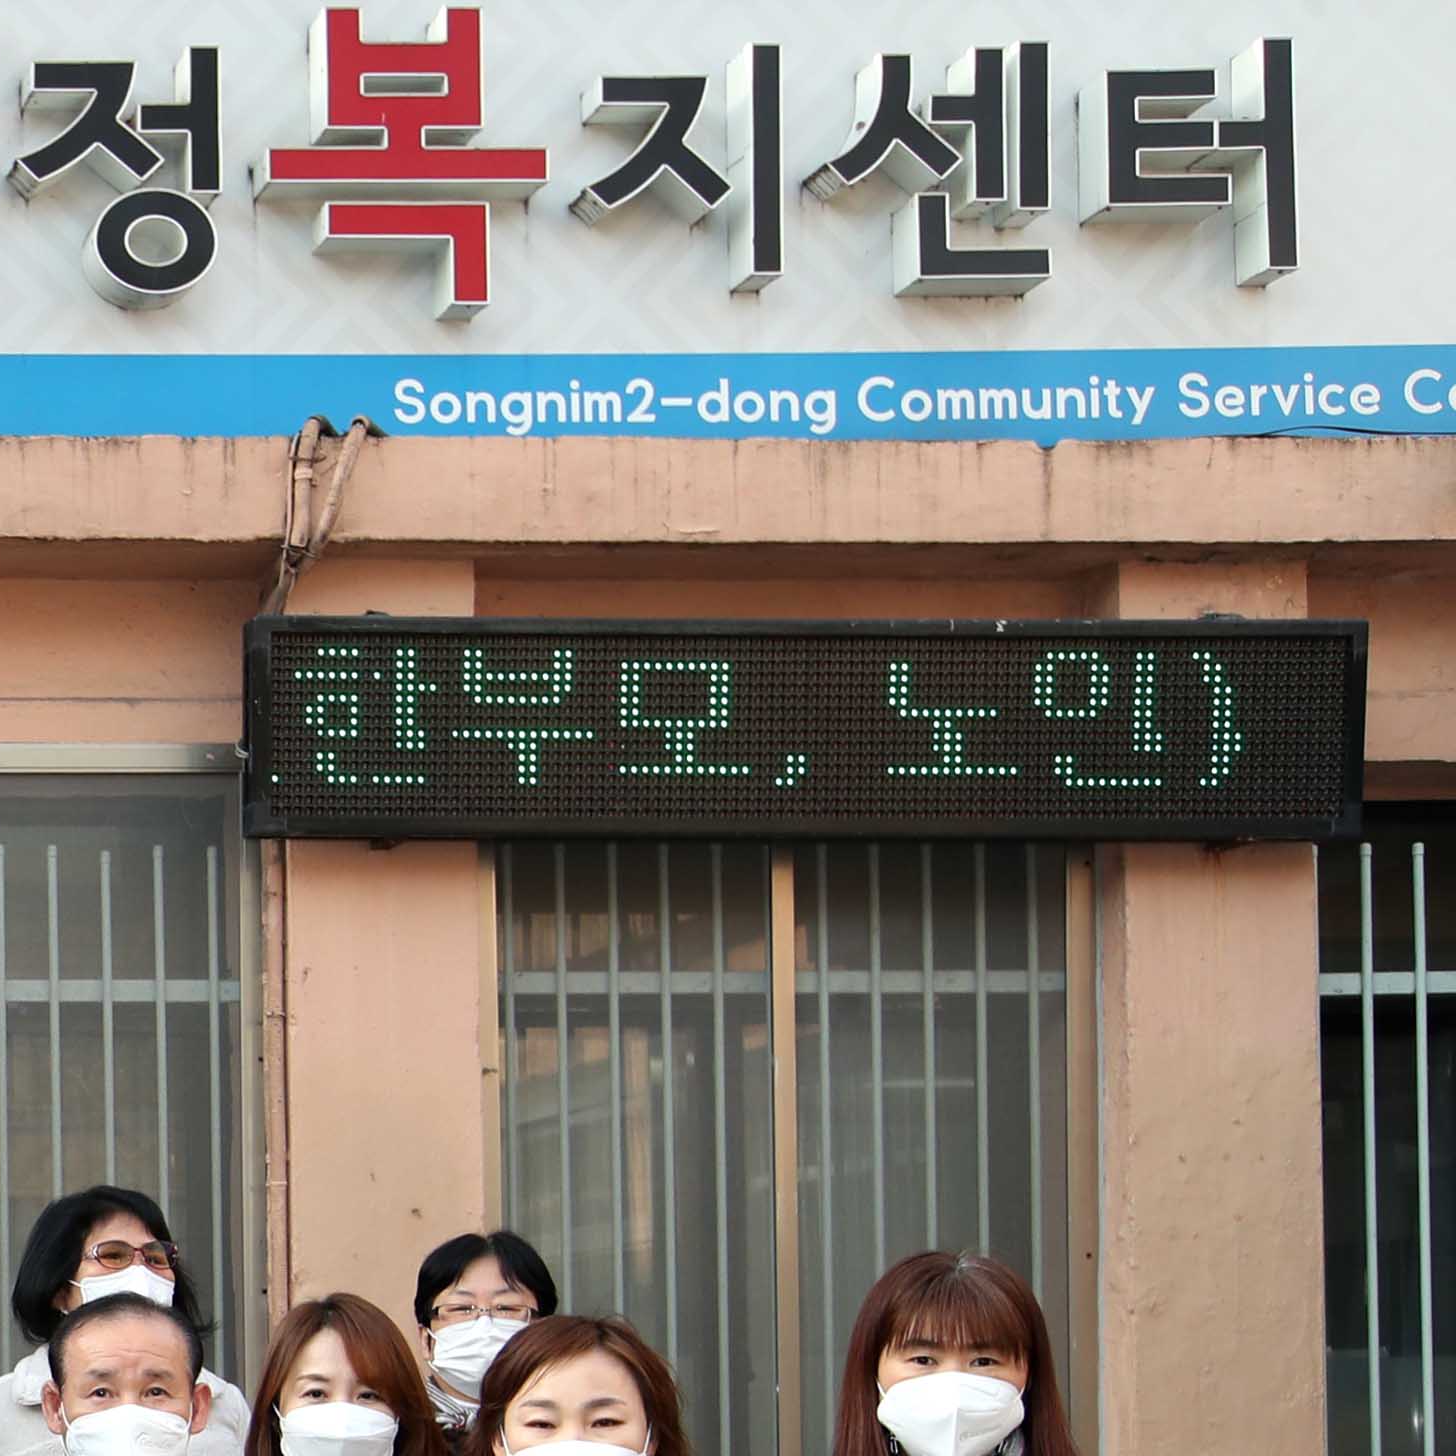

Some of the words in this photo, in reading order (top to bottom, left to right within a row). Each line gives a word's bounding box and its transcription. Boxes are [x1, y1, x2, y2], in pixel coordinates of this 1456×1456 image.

[394, 378, 837, 435] Songnim2-dong
[857, 375, 1155, 425] Community
[1178, 372, 1381, 418] Service
[294, 648, 805, 786] 한부모,
[887, 652, 1241, 786] 노인)
